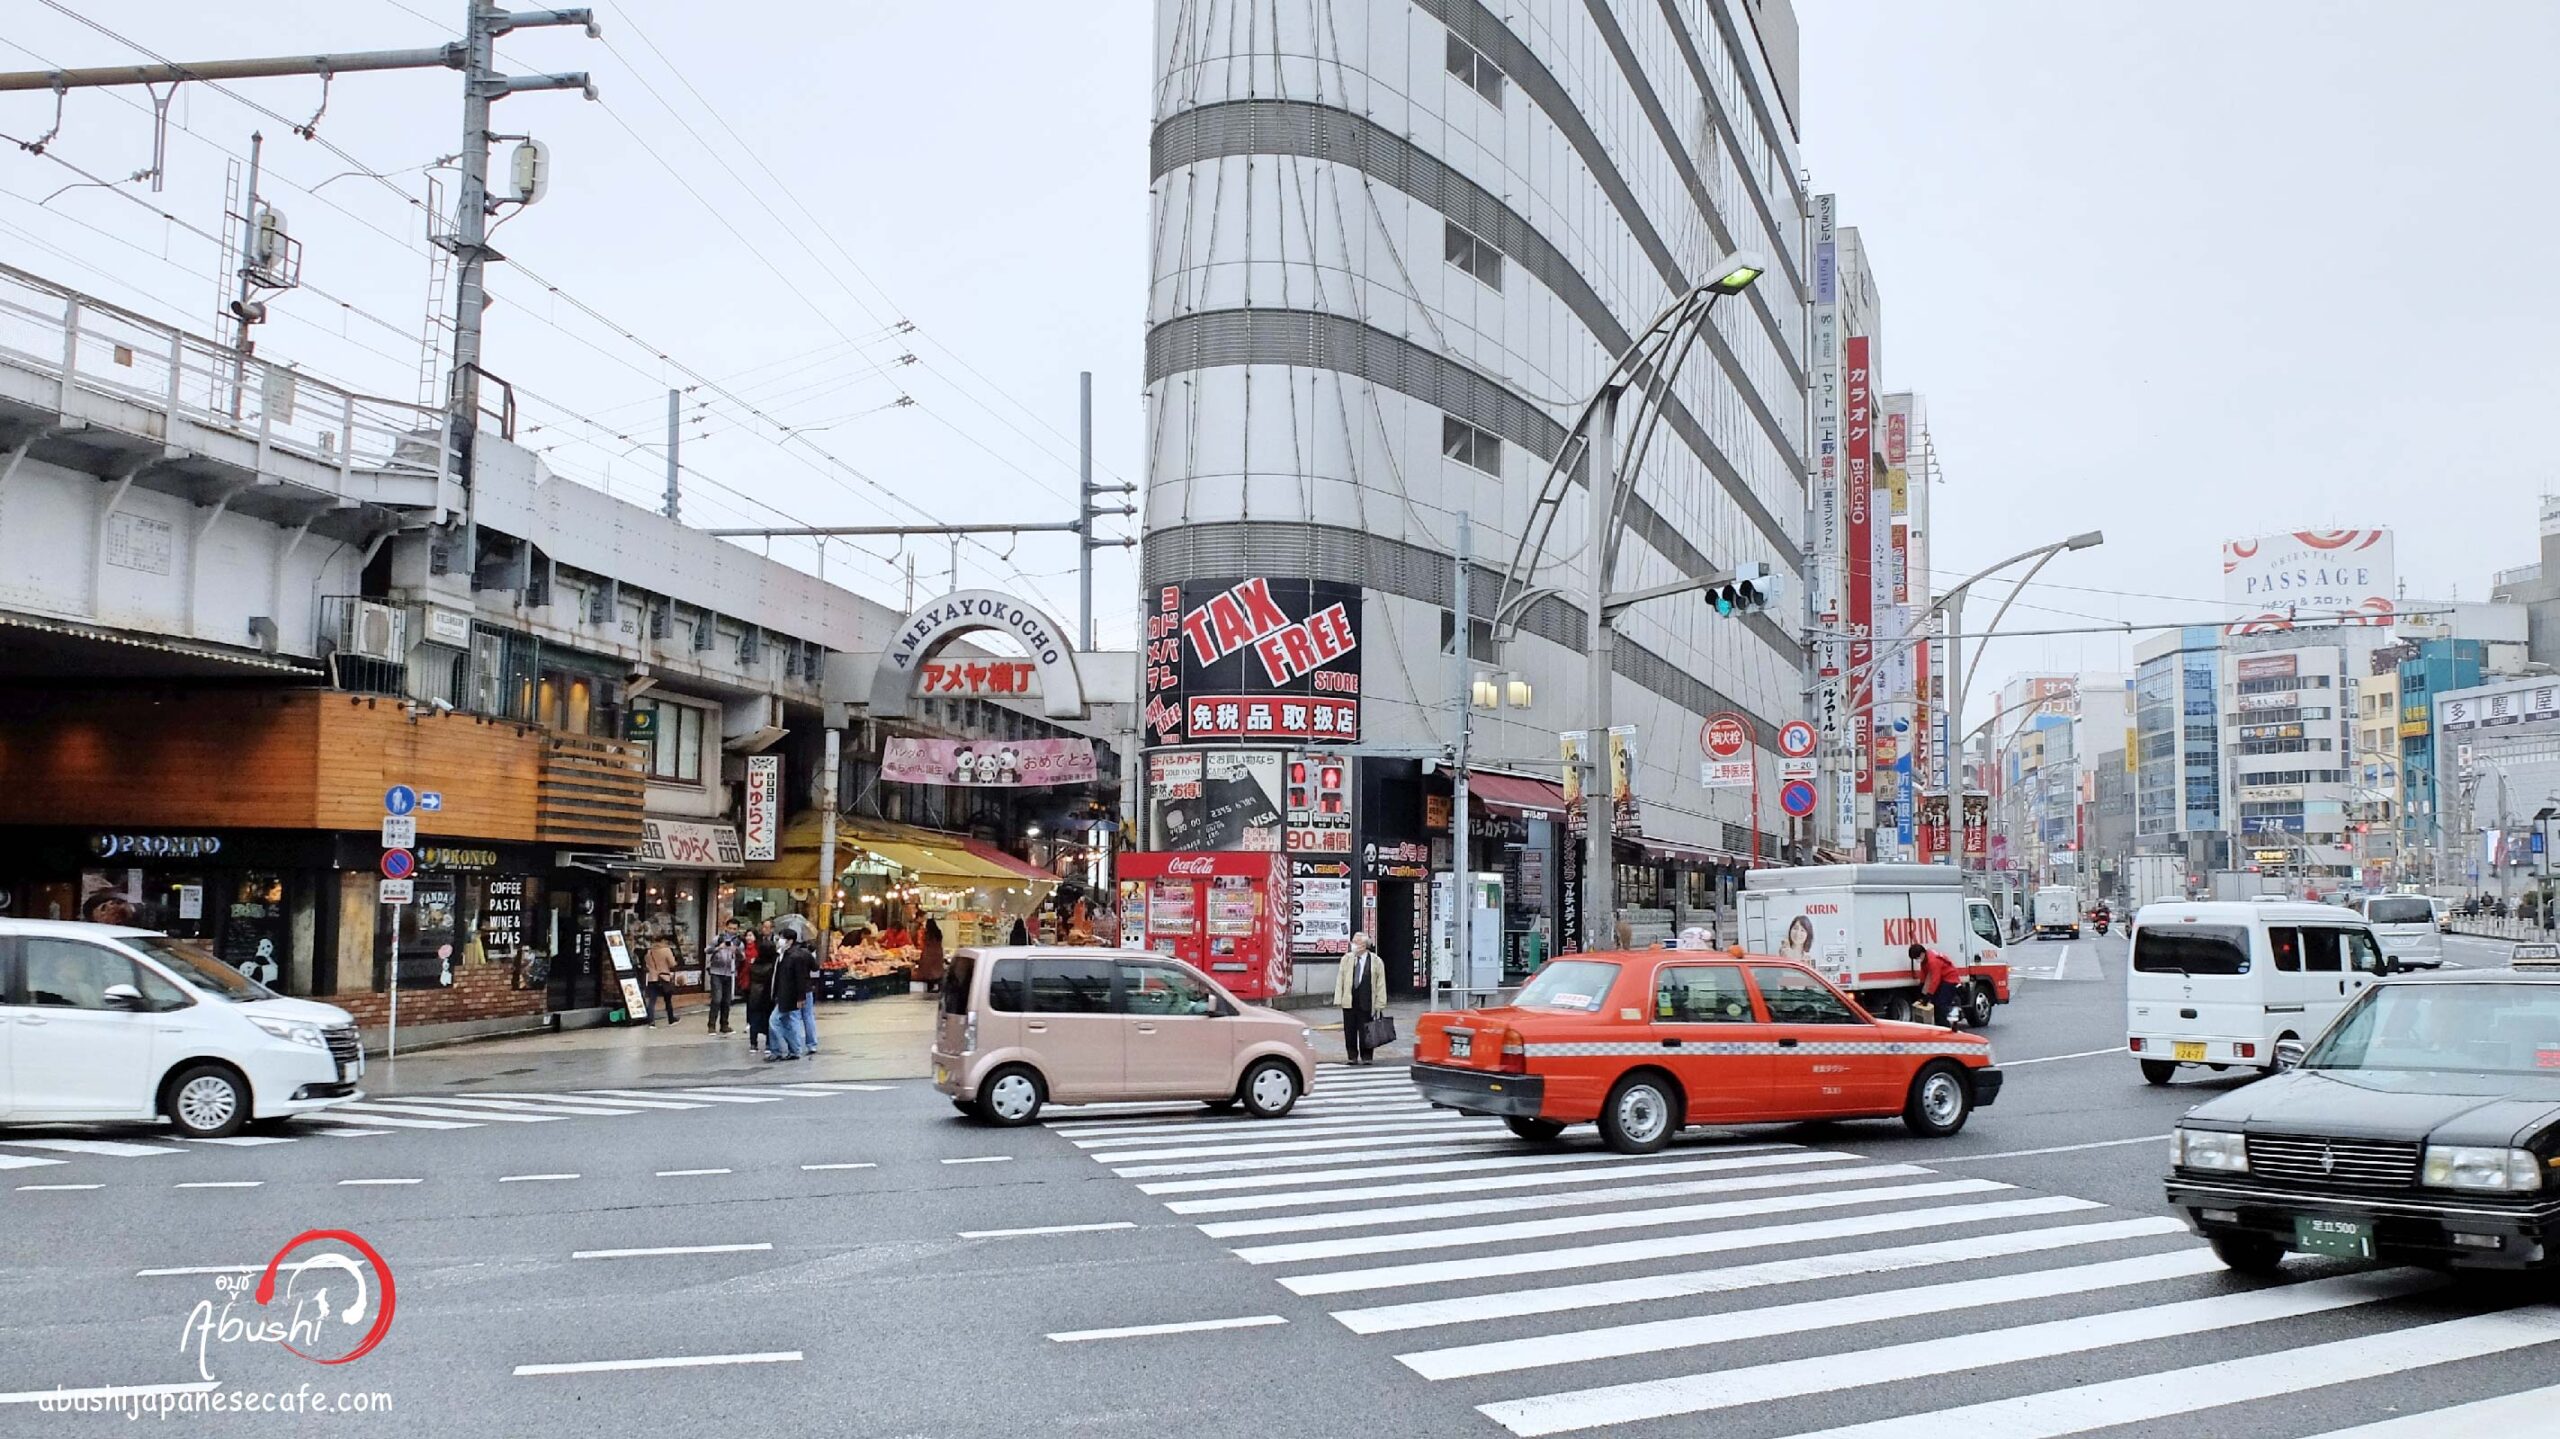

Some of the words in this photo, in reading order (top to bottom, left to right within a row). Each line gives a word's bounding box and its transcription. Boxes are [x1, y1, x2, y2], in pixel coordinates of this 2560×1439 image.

[1820, 197, 1831, 241] タツミビル
[1823, 372, 1833, 408] ヤマト
[1850, 367, 1868, 441] カラオケ
[1821, 430, 1835, 481] 上野歯科
[2270, 550, 2338, 569] ORIENTAL
[2246, 568, 2370, 594] PASSAGE
[2313, 596, 2353, 606] スロット
[892, 599, 1058, 669] AMEYAYOKOCHO
[1184, 577, 1292, 669] TAX
[1254, 601, 1357, 688] FREE
[922, 662, 1036, 693] アメヤ横丁
[1314, 671, 1359, 694] STORE
[1145, 694, 1166, 728] TAX
[1155, 703, 1182, 737] FREE
[1193, 703, 1355, 734] 免税品取扱店
[1823, 688, 1837, 732] ルノアール
[1710, 730, 1741, 746] 消火栓
[1151, 754, 1201, 766] ヨドバシカメラ
[1711, 763, 1751, 779] 上野医院
[749, 771, 764, 843] じゅらく
[1842, 775, 1854, 826] ほけん案内
[1249, 811, 1278, 827] VISA
[118, 835, 221, 855] PRONTO
[440, 848, 498, 866] PRONTO
[667, 834, 715, 863] じゅらく
[490, 881, 522, 895] COFFEE
[489, 898, 521, 911] PASTA
[1805, 904, 1839, 915] KIRIN
[489, 931, 521, 945] TAPAS
[1883, 917, 1939, 946] KIRIN
[1981, 950, 1998, 959] KIRIN
[2335, 1221, 2357, 1234] 500
